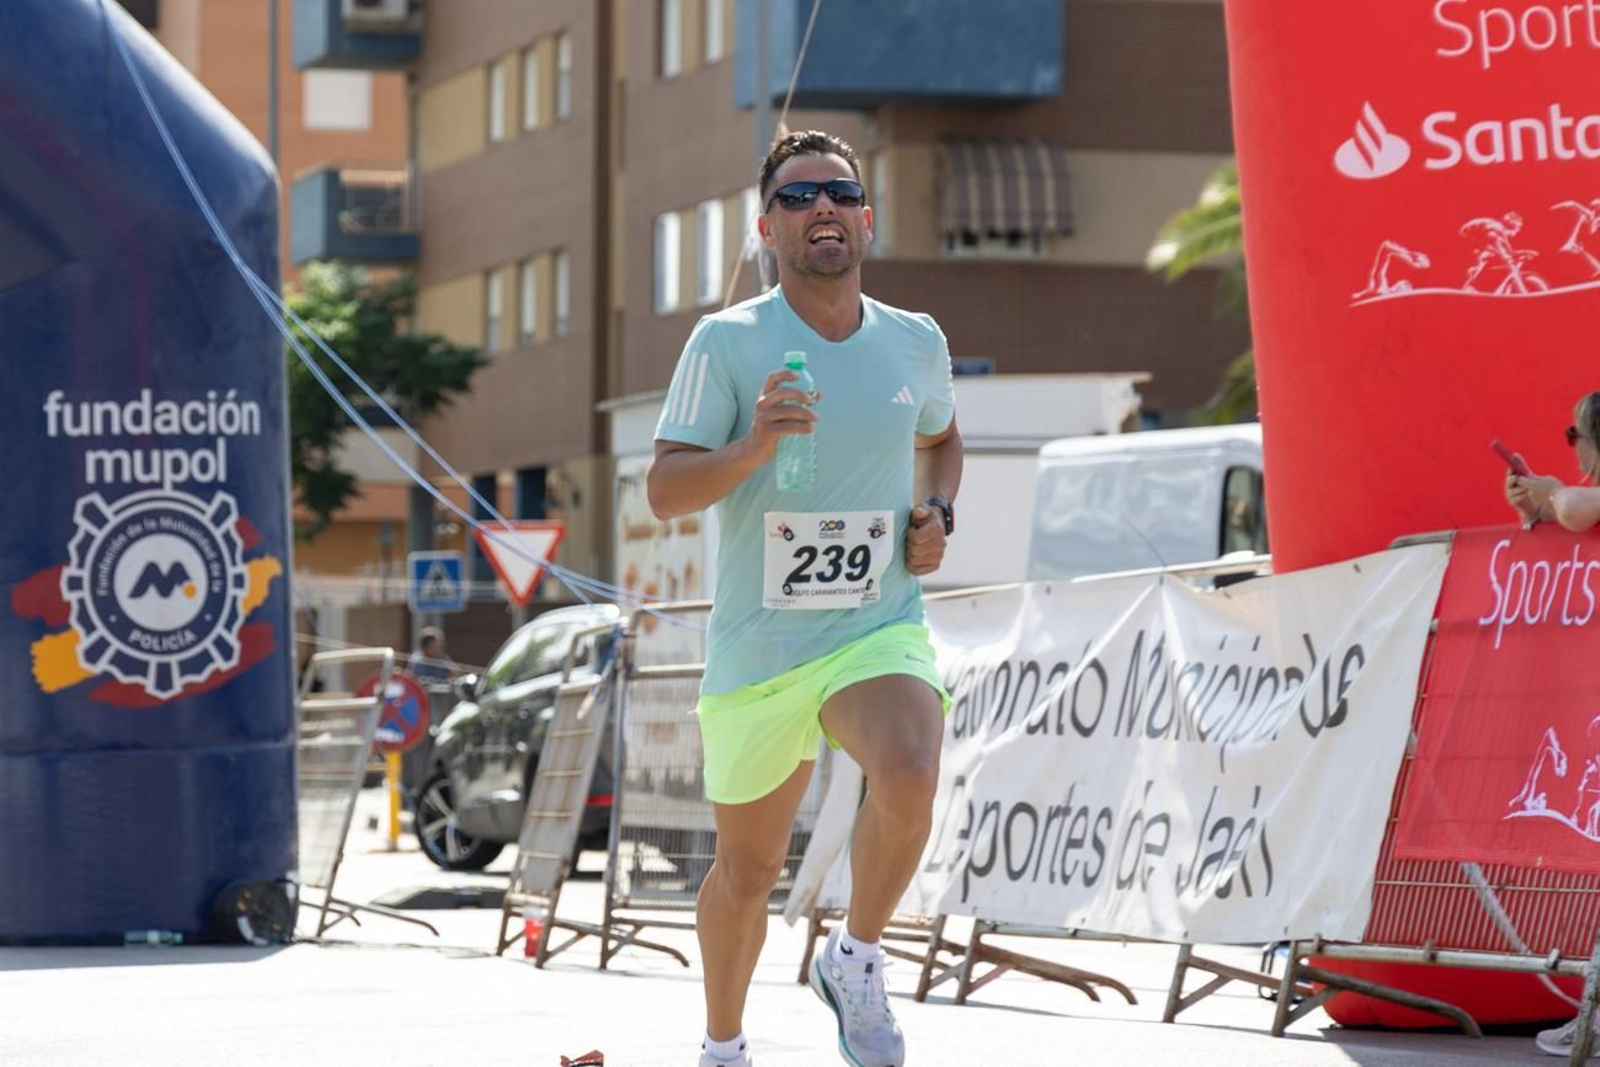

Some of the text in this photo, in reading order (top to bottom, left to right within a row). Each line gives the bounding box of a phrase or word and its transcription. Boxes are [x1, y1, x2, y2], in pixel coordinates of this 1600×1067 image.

[1434, 0, 1600, 70] Sport
[1422, 103, 1600, 171] Santa
[43, 388, 261, 437] fundación
[85, 437, 227, 490] mupol
[785, 544, 871, 583] 239
[1479, 539, 1600, 650] Sports
[128, 629, 197, 651] POLICÍA
